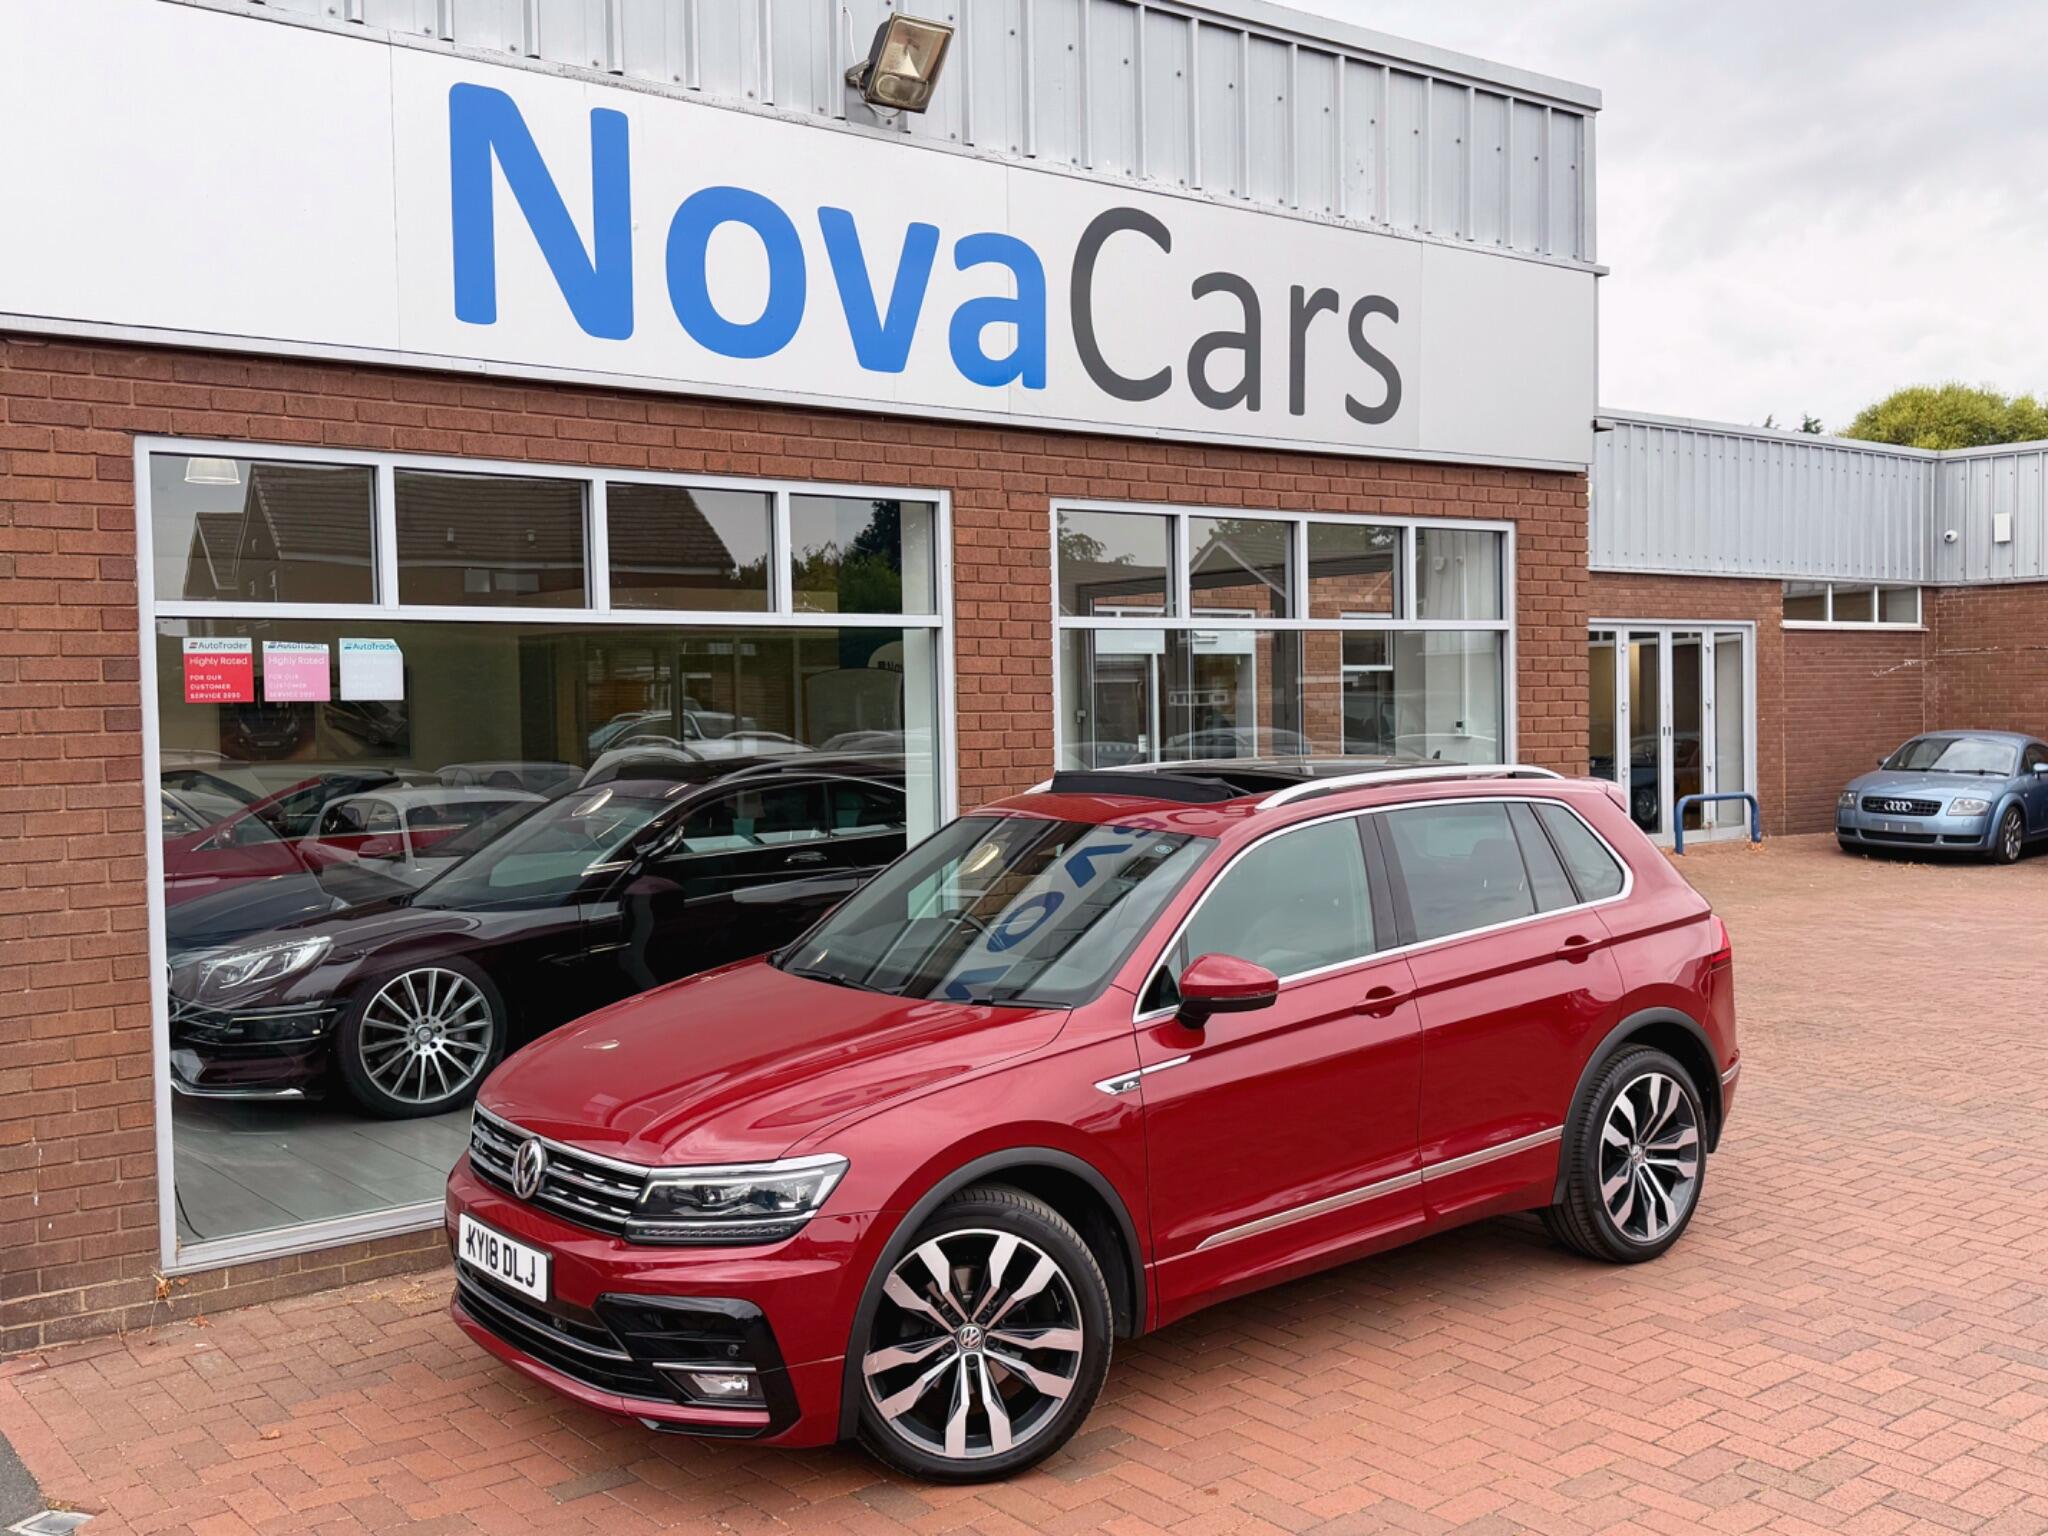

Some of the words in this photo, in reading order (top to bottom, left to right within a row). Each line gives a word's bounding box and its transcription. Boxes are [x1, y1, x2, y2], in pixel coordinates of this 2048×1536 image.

[449, 81, 1403, 426] NovaCars
[197, 641, 248, 650] AutoTrader
[189, 656, 218, 667] Highly
[220, 656, 248, 666] Rated
[268, 656, 297, 667] Highly
[466, 1223, 499, 1270] KY18
[502, 1242, 536, 1288] DLJ
